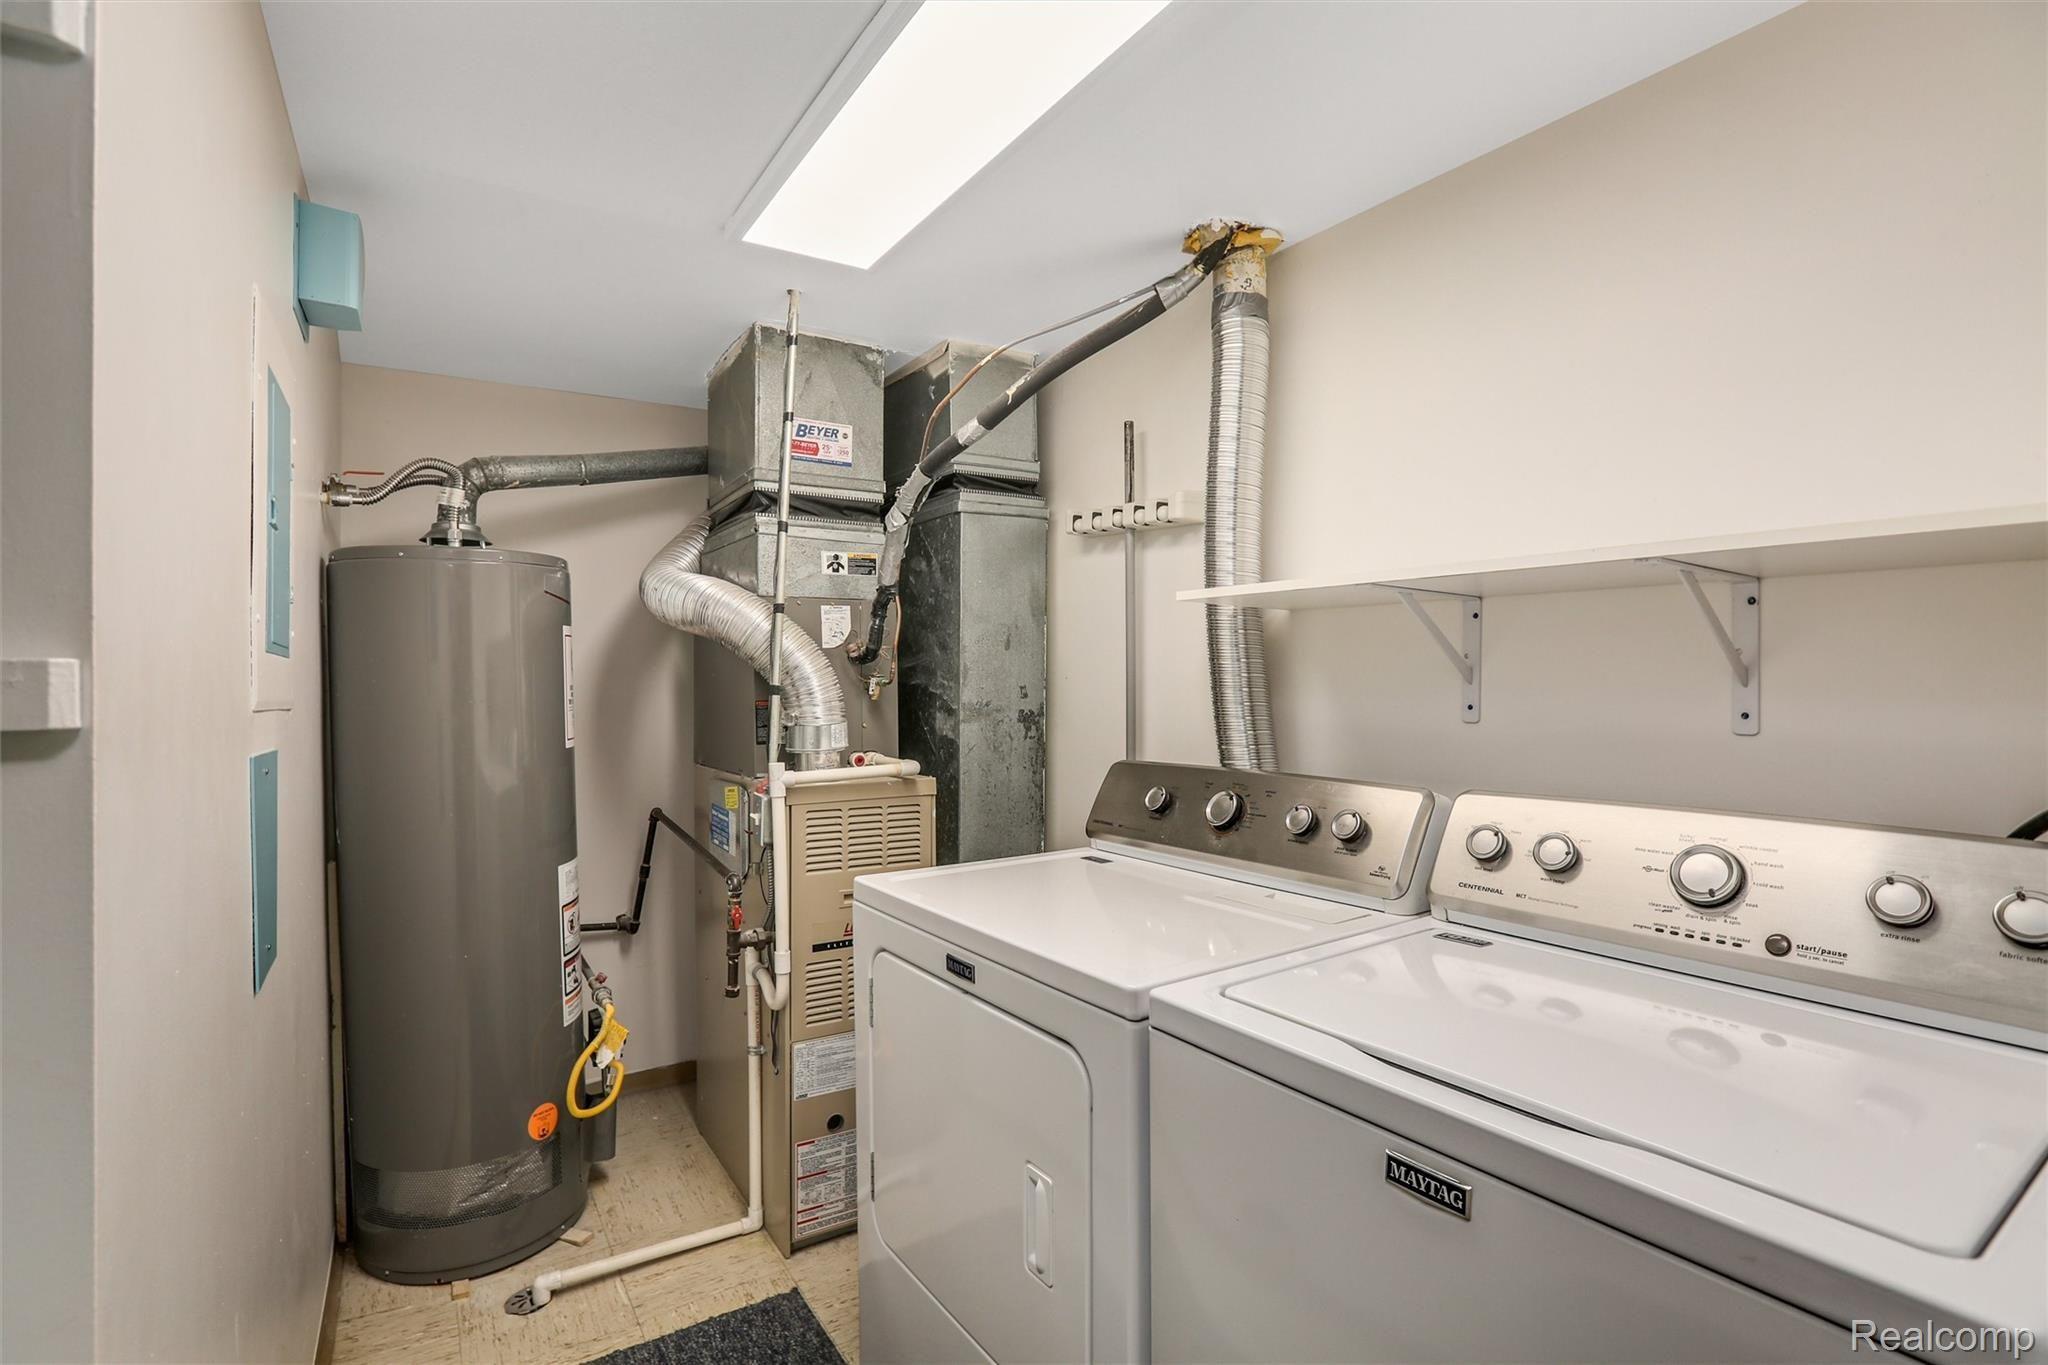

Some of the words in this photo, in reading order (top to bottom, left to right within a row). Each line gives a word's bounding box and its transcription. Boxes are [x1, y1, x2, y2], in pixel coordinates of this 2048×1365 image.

[795, 423, 839, 439] BEYER
[1458, 881, 1505, 896] CENTENNIAL
[1880, 932, 1900, 940] extra
[1900, 934, 1921, 944] rinse
[1796, 943, 1848, 959] start/pause
[1999, 950, 2023, 961] fabric
[1389, 1160, 1463, 1209] MAYTAG
